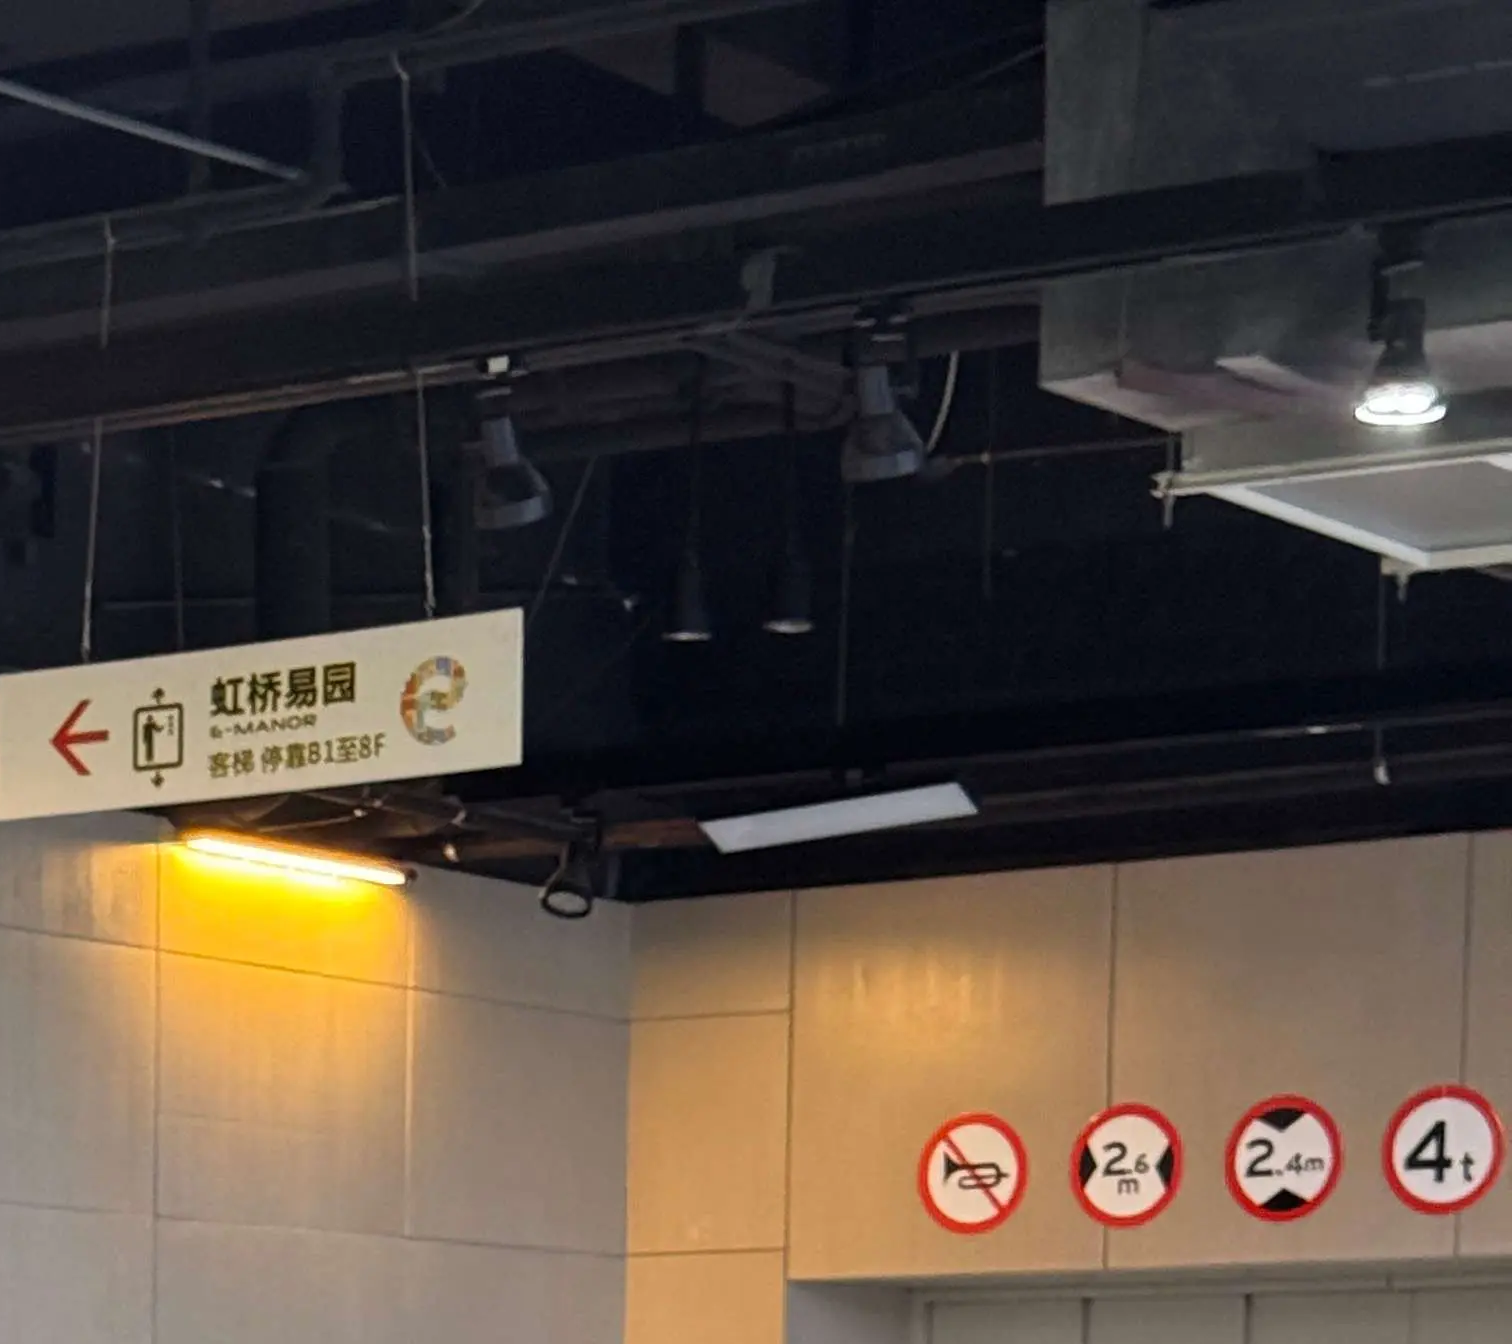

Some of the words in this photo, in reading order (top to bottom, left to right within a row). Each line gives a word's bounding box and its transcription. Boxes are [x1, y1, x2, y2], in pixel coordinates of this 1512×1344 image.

[210, 660, 356, 716] 虹桥易园
[1102, 1140, 1150, 1178] 2.6
